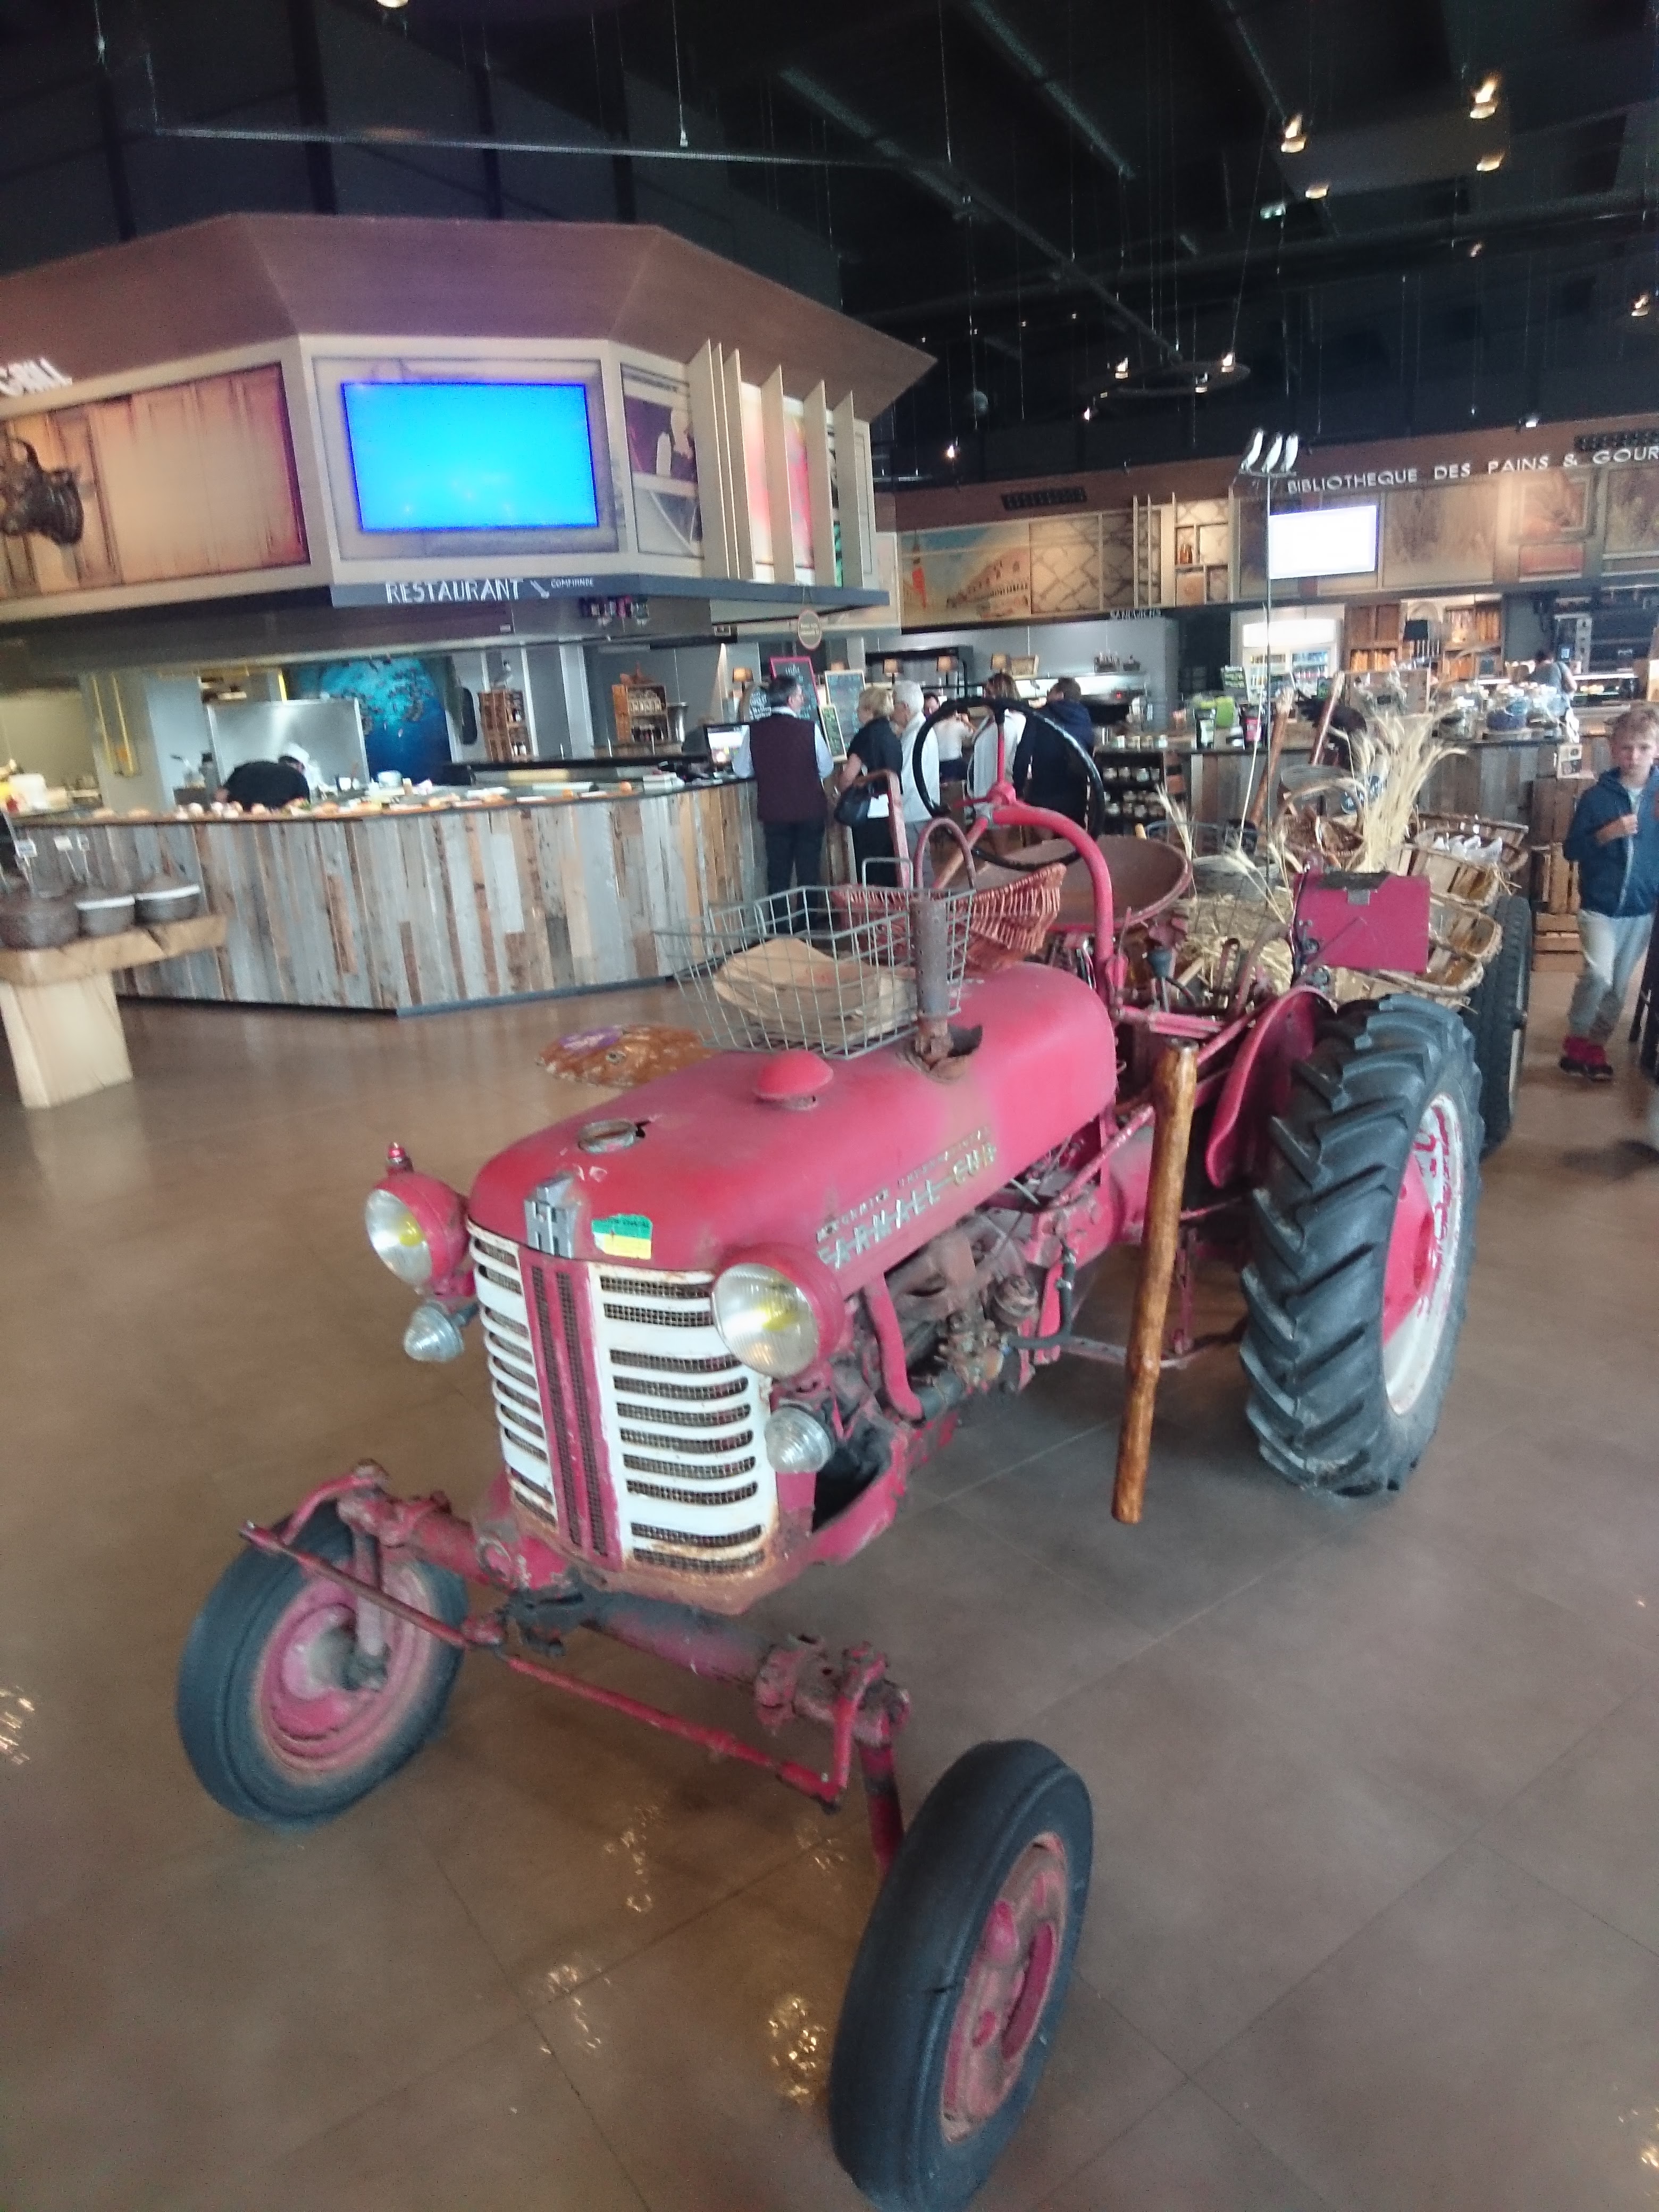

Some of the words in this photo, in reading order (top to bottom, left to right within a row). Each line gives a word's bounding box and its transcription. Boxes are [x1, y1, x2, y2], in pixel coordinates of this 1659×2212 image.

[1287, 468, 1418, 495] BIBLIOTHEQUE
[1434, 463, 1471, 480] DES
[1489, 455, 1549, 475] PAINS
[386, 579, 524, 604] RESTAURANT
